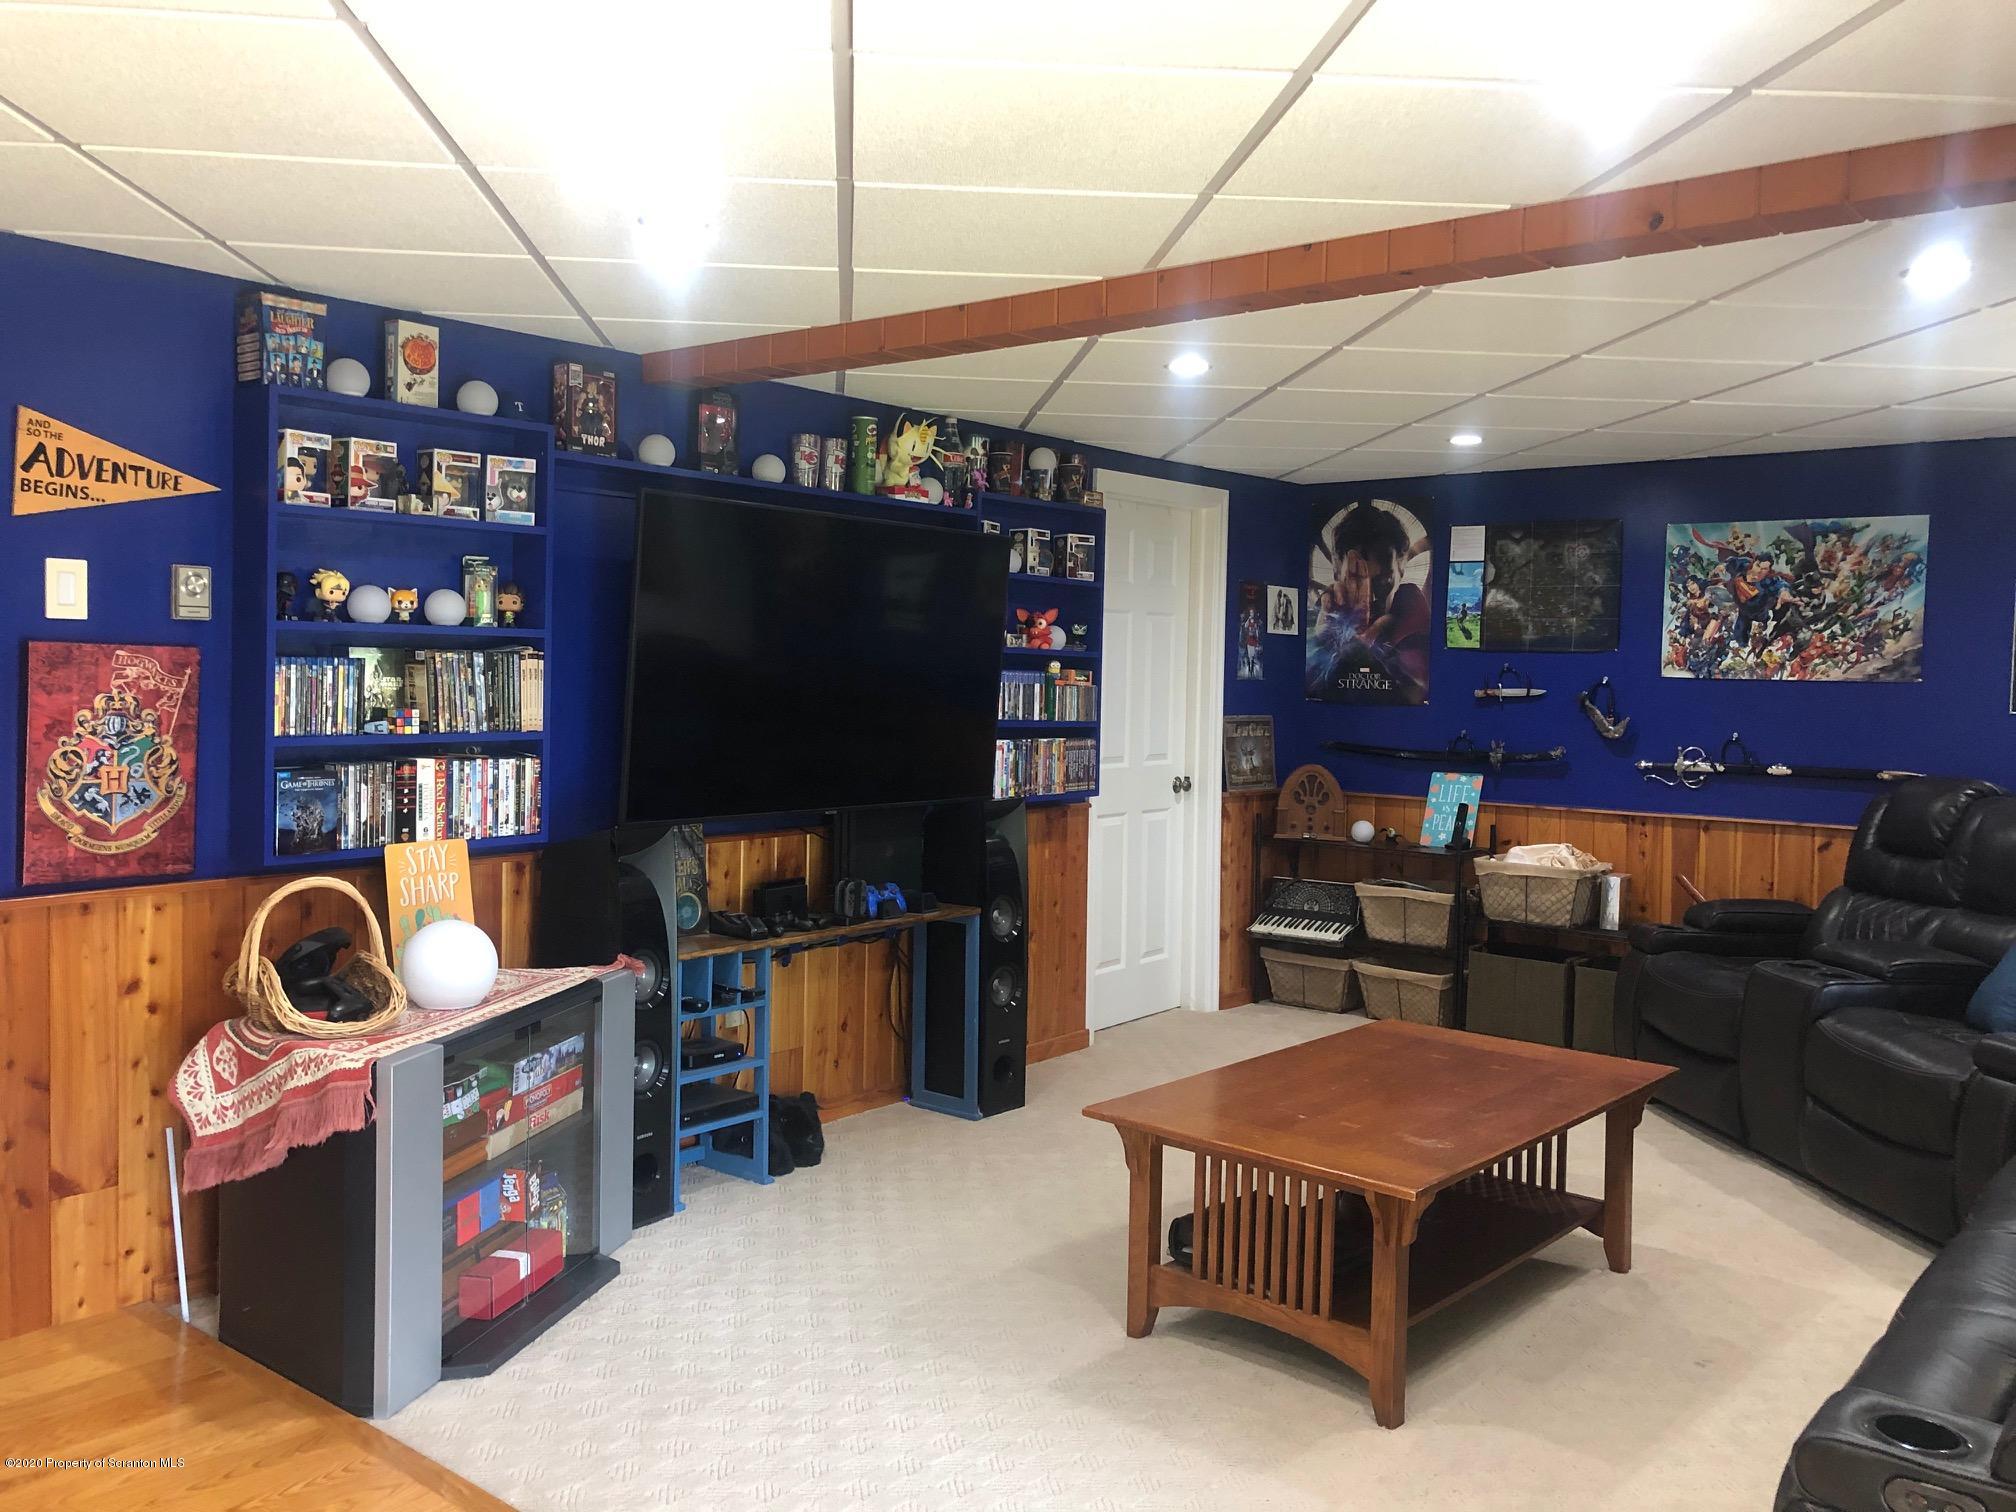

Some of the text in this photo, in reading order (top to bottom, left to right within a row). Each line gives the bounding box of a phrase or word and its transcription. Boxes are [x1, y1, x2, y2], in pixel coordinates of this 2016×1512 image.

[27, 418, 51, 429] AND
[26, 428, 63, 441] SO THE
[581, 433, 605, 447] THOR
[20, 441, 183, 491] ADVENTURE
[20, 478, 106, 503] BEGINS...
[117, 655, 178, 686] HOGWARTS
[1337, 679, 1392, 690] STRANGE
[105, 770, 122, 791] H
[281, 780, 302, 789] GAME
[306, 779, 336, 788] THRONES
[1438, 784, 1472, 803] LIFE
[436, 779, 446, 840] Red Skelton
[1432, 814, 1457, 830] PEA
[405, 843, 449, 875] STAY
[400, 872, 459, 906] SHARP
[502, 1173, 520, 1202] Jenga
